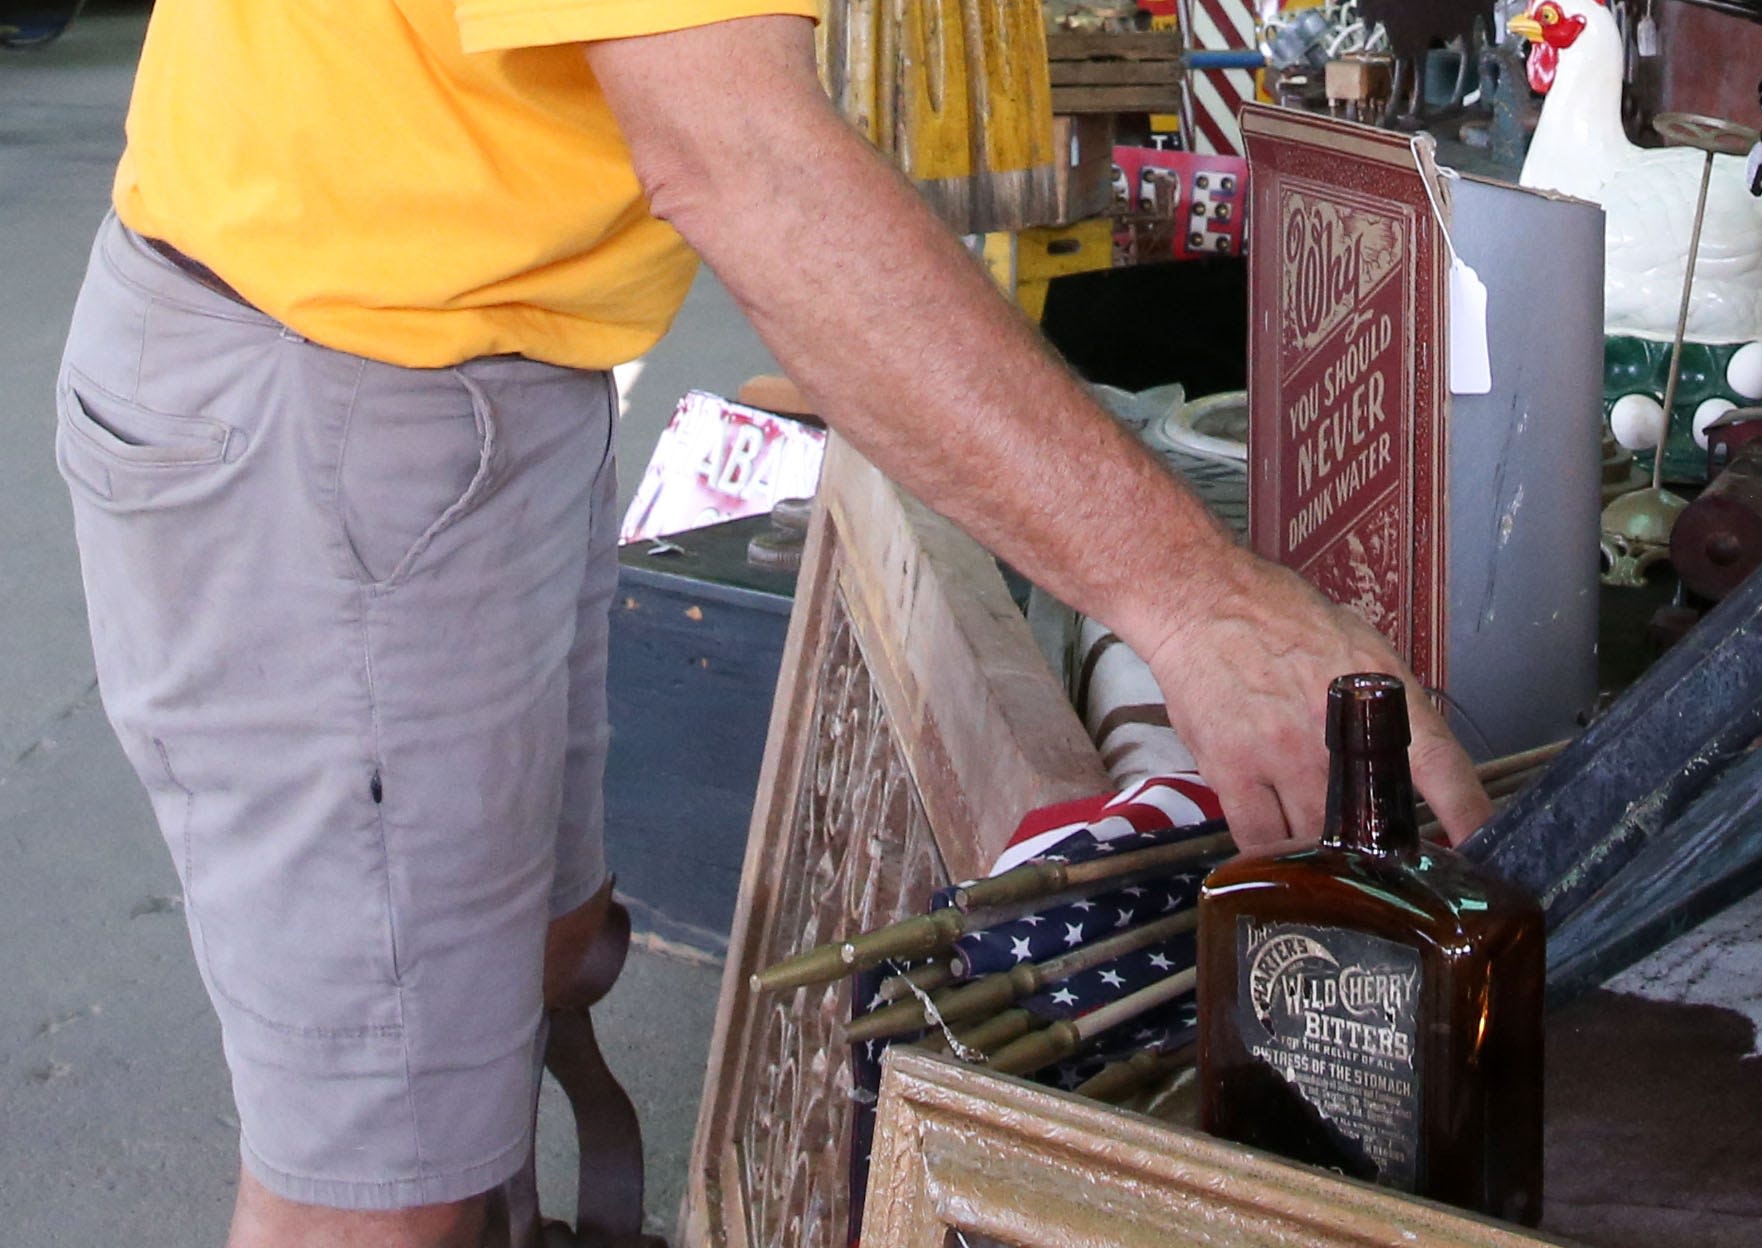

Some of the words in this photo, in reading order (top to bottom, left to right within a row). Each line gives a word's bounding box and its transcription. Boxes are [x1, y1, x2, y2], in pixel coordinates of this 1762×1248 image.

[1286, 206, 1375, 343] Why
[1290, 381, 1319, 440] YOU
[1324, 313, 1392, 407] SHOULD
[1289, 482, 1334, 551] DRINK
[1335, 431, 1392, 507] WATER
[1303, 1011, 1410, 1062] BITTERS
[1303, 1037, 1321, 1053] THE
[1377, 1059, 1396, 1071] ALL
[1312, 1059, 1326, 1074] OF
[1329, 1063, 1352, 1083] THE
[1355, 1070, 1411, 1097] STOMACH
